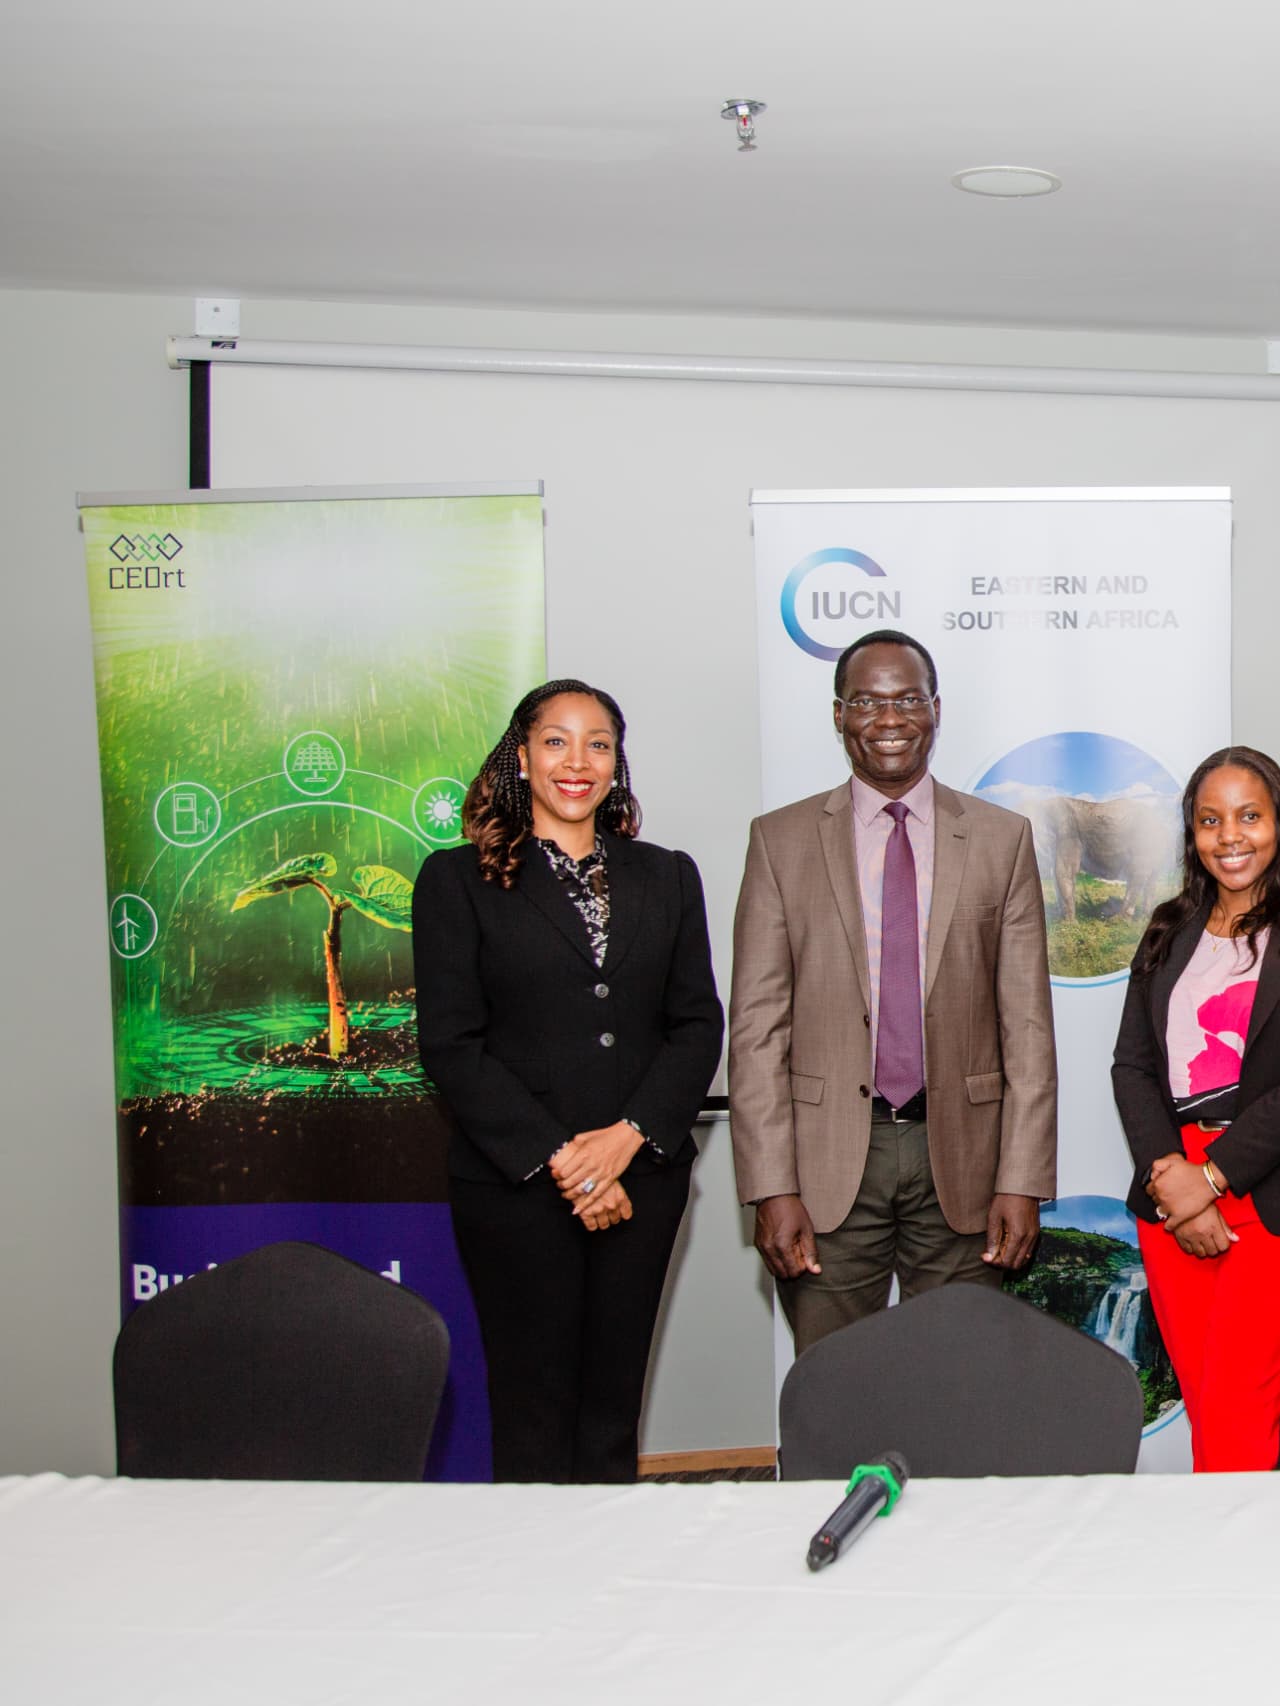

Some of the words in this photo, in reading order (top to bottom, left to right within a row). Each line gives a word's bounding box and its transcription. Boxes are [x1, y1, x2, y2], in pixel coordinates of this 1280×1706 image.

[109, 566, 186, 589] CEOrt
[970, 575, 1088, 596] EASTERN
[1095, 575, 1150, 595] AND
[811, 589, 902, 621] IUCN
[942, 609, 1079, 632] SOUTRN
[1085, 608, 1180, 630] AFRICA
